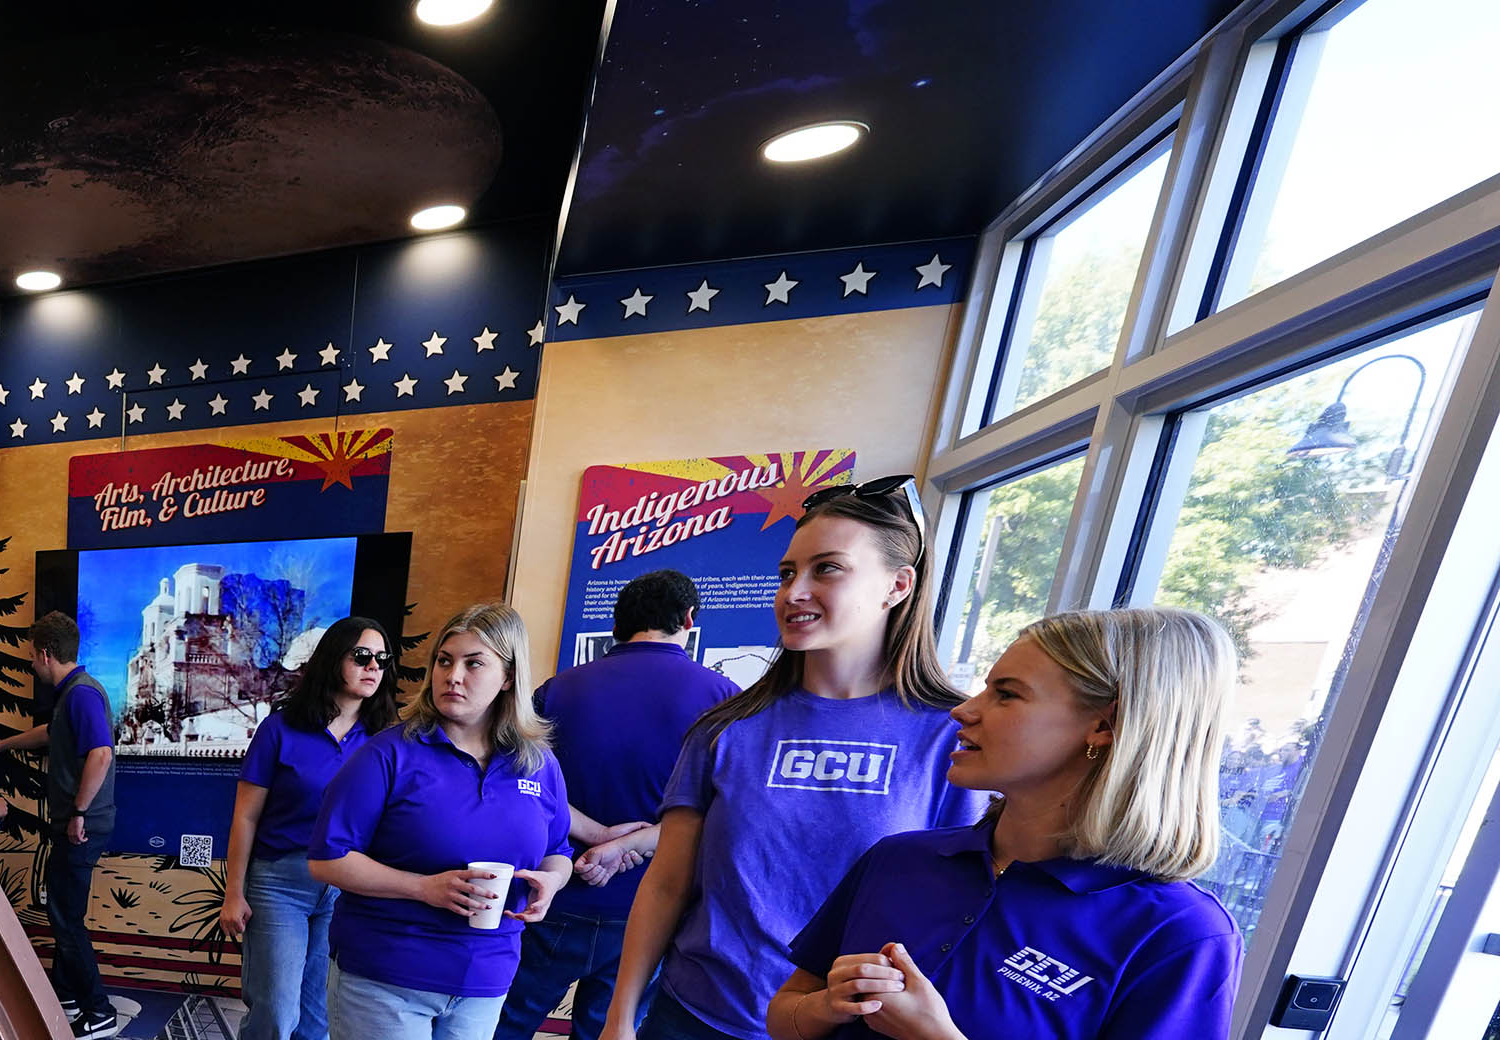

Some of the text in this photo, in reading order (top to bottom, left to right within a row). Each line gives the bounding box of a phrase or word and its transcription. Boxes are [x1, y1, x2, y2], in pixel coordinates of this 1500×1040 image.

[94, 458, 295, 511] Arts, Architecture,
[586, 463, 783, 535] Indigenous
[100, 487, 267, 532] Film, & Culture
[590, 505, 733, 569] Arizona
[517, 779, 541, 792] GCU
[780, 749, 885, 783] GCU
[997, 966, 1061, 1002] PHOENIX, AZ
[1003, 945, 1095, 995] GCU
